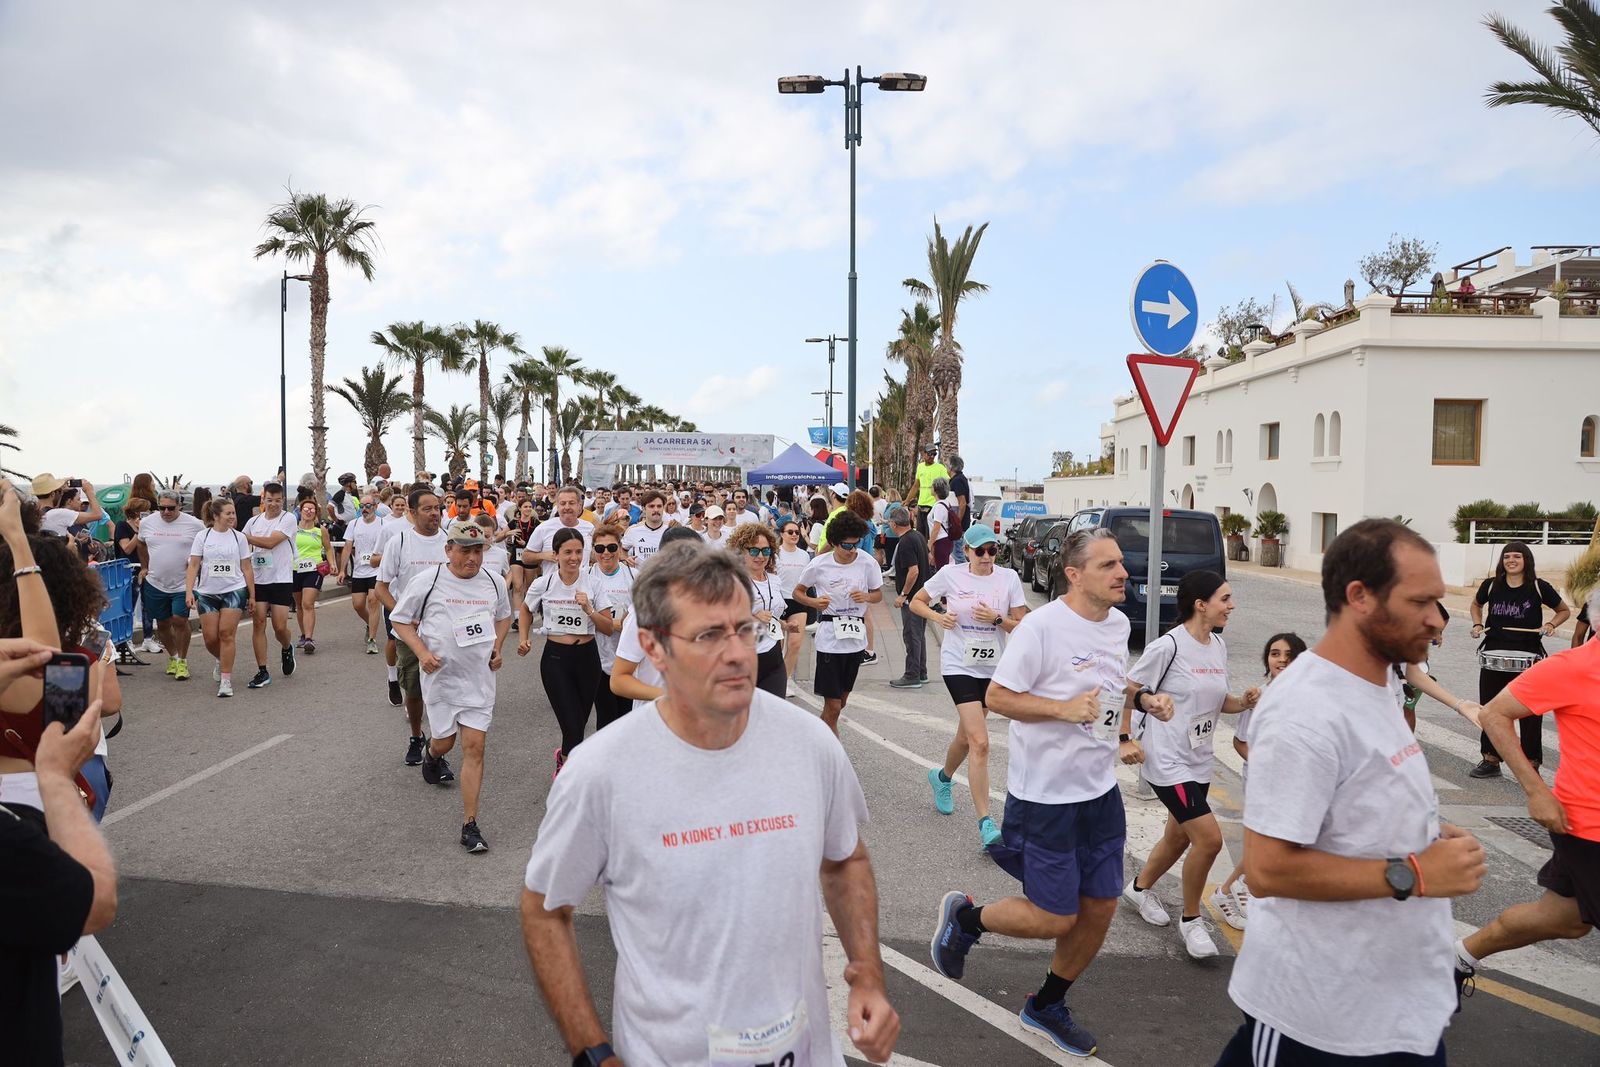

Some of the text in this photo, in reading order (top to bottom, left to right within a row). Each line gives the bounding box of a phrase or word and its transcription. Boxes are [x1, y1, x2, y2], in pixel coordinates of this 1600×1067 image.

[643, 437, 712, 446] 3A CARRERA 5K
[469, 528, 478, 538] 3
[557, 615, 582, 627] 296
[465, 623, 483, 636] 56
[840, 623, 861, 633] 718
[971, 647, 995, 659] 752
[1194, 719, 1212, 737] 149
[662, 832, 678, 848] NO
[729, 822, 744, 838] NO
